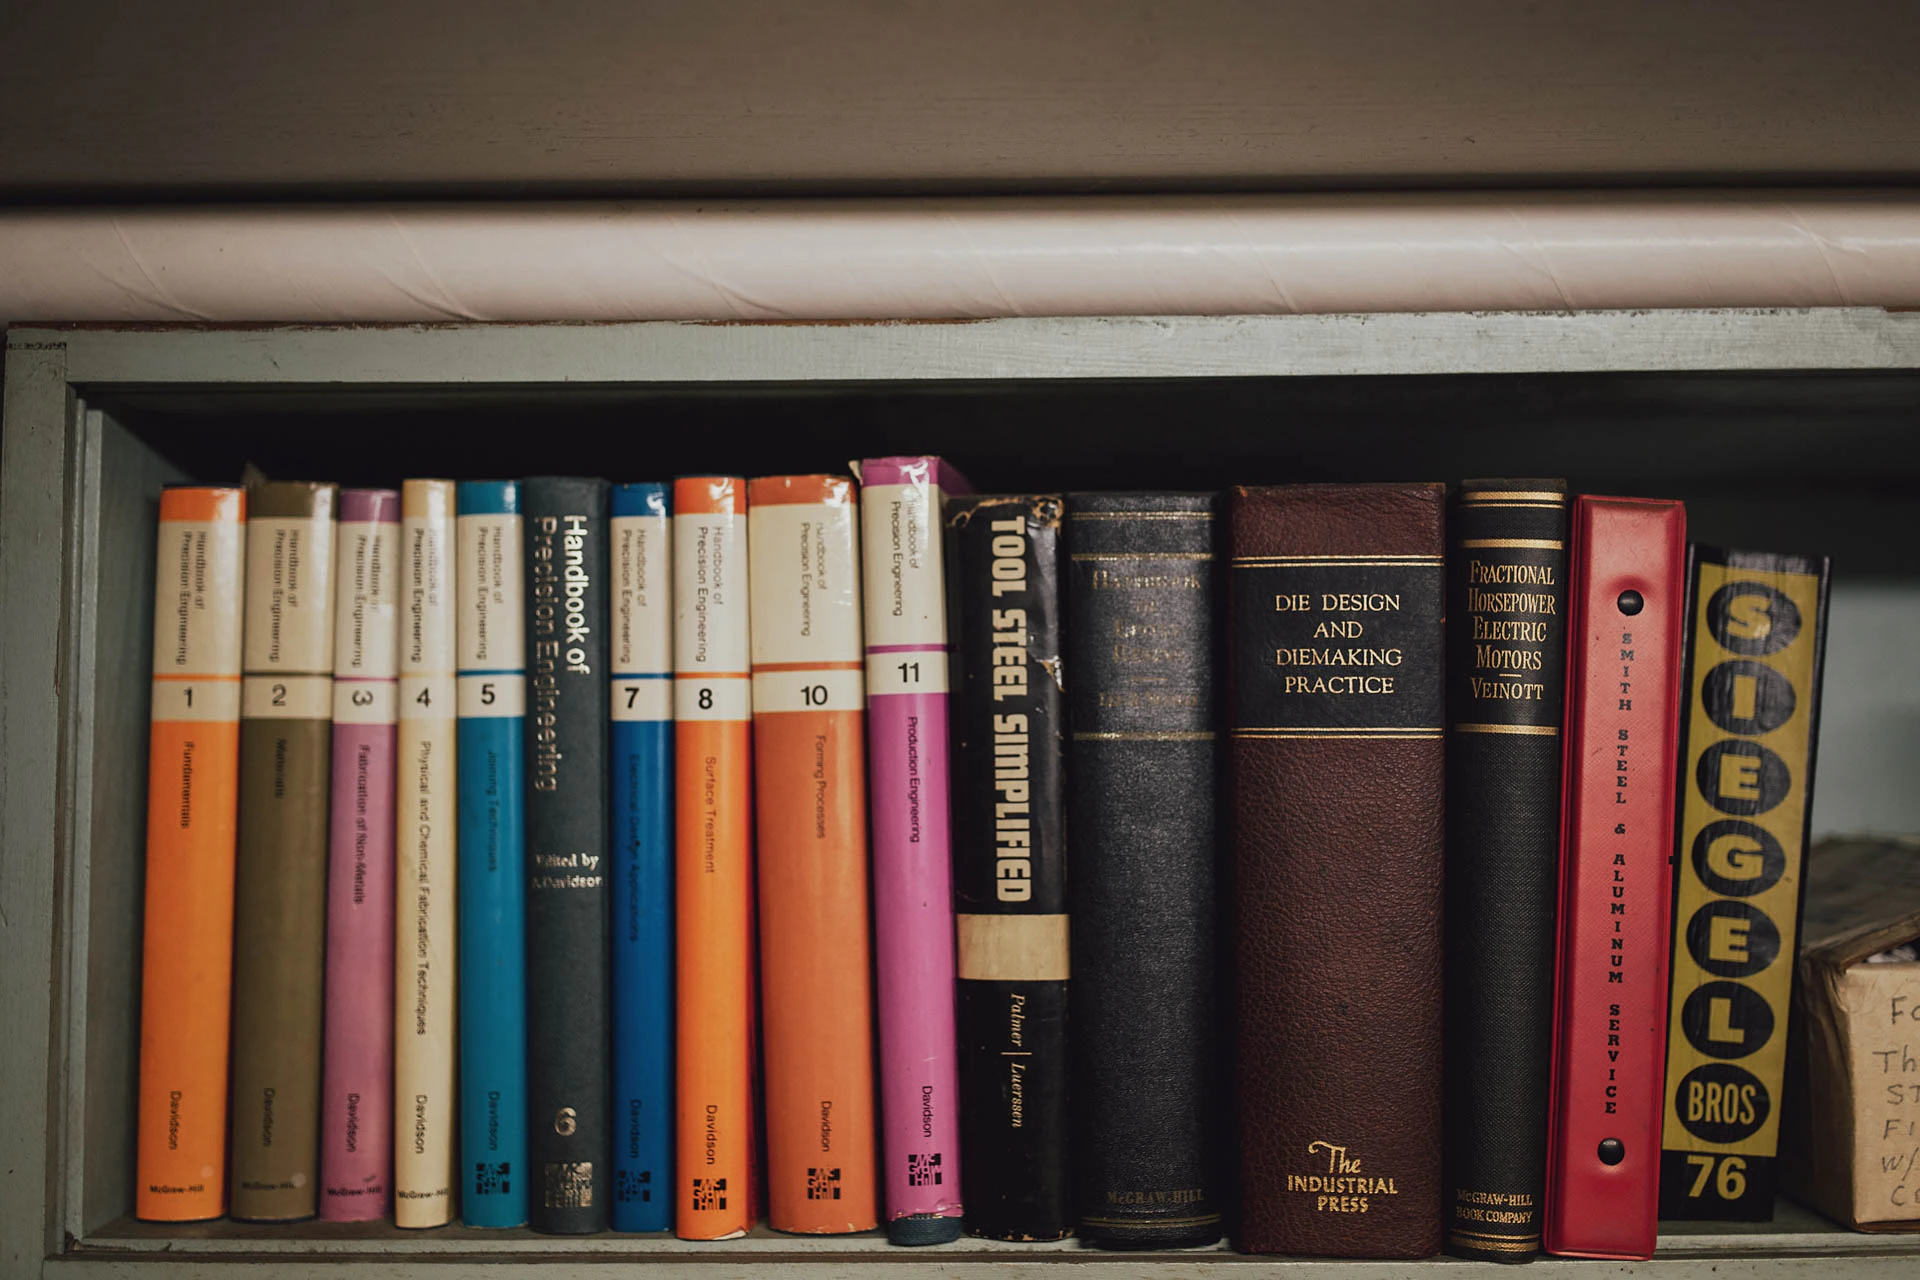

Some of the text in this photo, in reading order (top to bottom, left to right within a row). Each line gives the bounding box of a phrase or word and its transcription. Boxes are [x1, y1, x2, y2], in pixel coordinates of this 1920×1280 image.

[712, 526, 724, 605] Handbook of
[890, 501, 904, 617] Precision Engineering
[909, 557, 919, 569] of
[1470, 560, 1555, 586] FRACTIONAL
[564, 514, 591, 675] Handbook of
[695, 527, 709, 663] Precision Engineering
[800, 522, 813, 637] Precision Engineering
[1275, 593, 1400, 612] DIE DESIGN
[1467, 587, 1556, 615] HORSEPOWER
[1313, 620, 1363, 639] AND
[1472, 616, 1547, 642] ELECTRIC
[534, 516, 563, 791] Precision Engineering
[1276, 648, 1402, 667] DIEMAKING
[1475, 644, 1542, 671] MOTORS
[898, 662, 919, 683] 11
[1285, 676, 1394, 694] PRACTICE
[1470, 677, 1544, 700] VEINOTT
[184, 688, 192, 707] 1
[272, 685, 287, 707] 2
[352, 690, 373, 705] 3
[416, 688, 431, 707] 4
[481, 683, 495, 705] 5
[624, 687, 639, 708] 7
[698, 688, 713, 710] 8
[800, 685, 828, 706] 10
[991, 516, 1031, 901] TOOL STEEL SIMPLIFIED
[814, 735, 828, 839] Forming Processes
[907, 716, 921, 843] Production Engineering
[704, 757, 717, 874] Surface Treatment
[1707, 593, 1773, 1044] SIEGEL
[581, 853, 599, 871] by
[1605, 633, 1635, 1115] SMITH STEEL & ALUMINUM SERVICE
[415, 741, 431, 1035] Physical and Chemical Fabrication Techniques
[1010, 993, 1026, 1128] Palmer Luerssen
[262, 1088, 276, 1147] Davidson
[921, 1086, 934, 1138] Davidson
[1687, 1080, 1757, 1125] BROS
[168, 1091, 181, 1150] Davidson
[346, 1093, 360, 1152] Davidson
[415, 1094, 428, 1154] Davidson
[488, 1091, 500, 1150] Davidson
[554, 1107, 577, 1137] 6
[629, 1099, 642, 1159] Davidson
[705, 1105, 717, 1165] Davidson
[820, 1101, 833, 1152] Davidson
[1308, 1140, 1362, 1174] The
[1288, 1174, 1398, 1195] INDUSTRIAL
[1686, 1155, 1748, 1200] 76
[1317, 1196, 1369, 1214] PRESS
[1456, 1188, 1533, 1207] McGRAW-HILL
[1456, 1205, 1533, 1225] BOOK COMPANY
